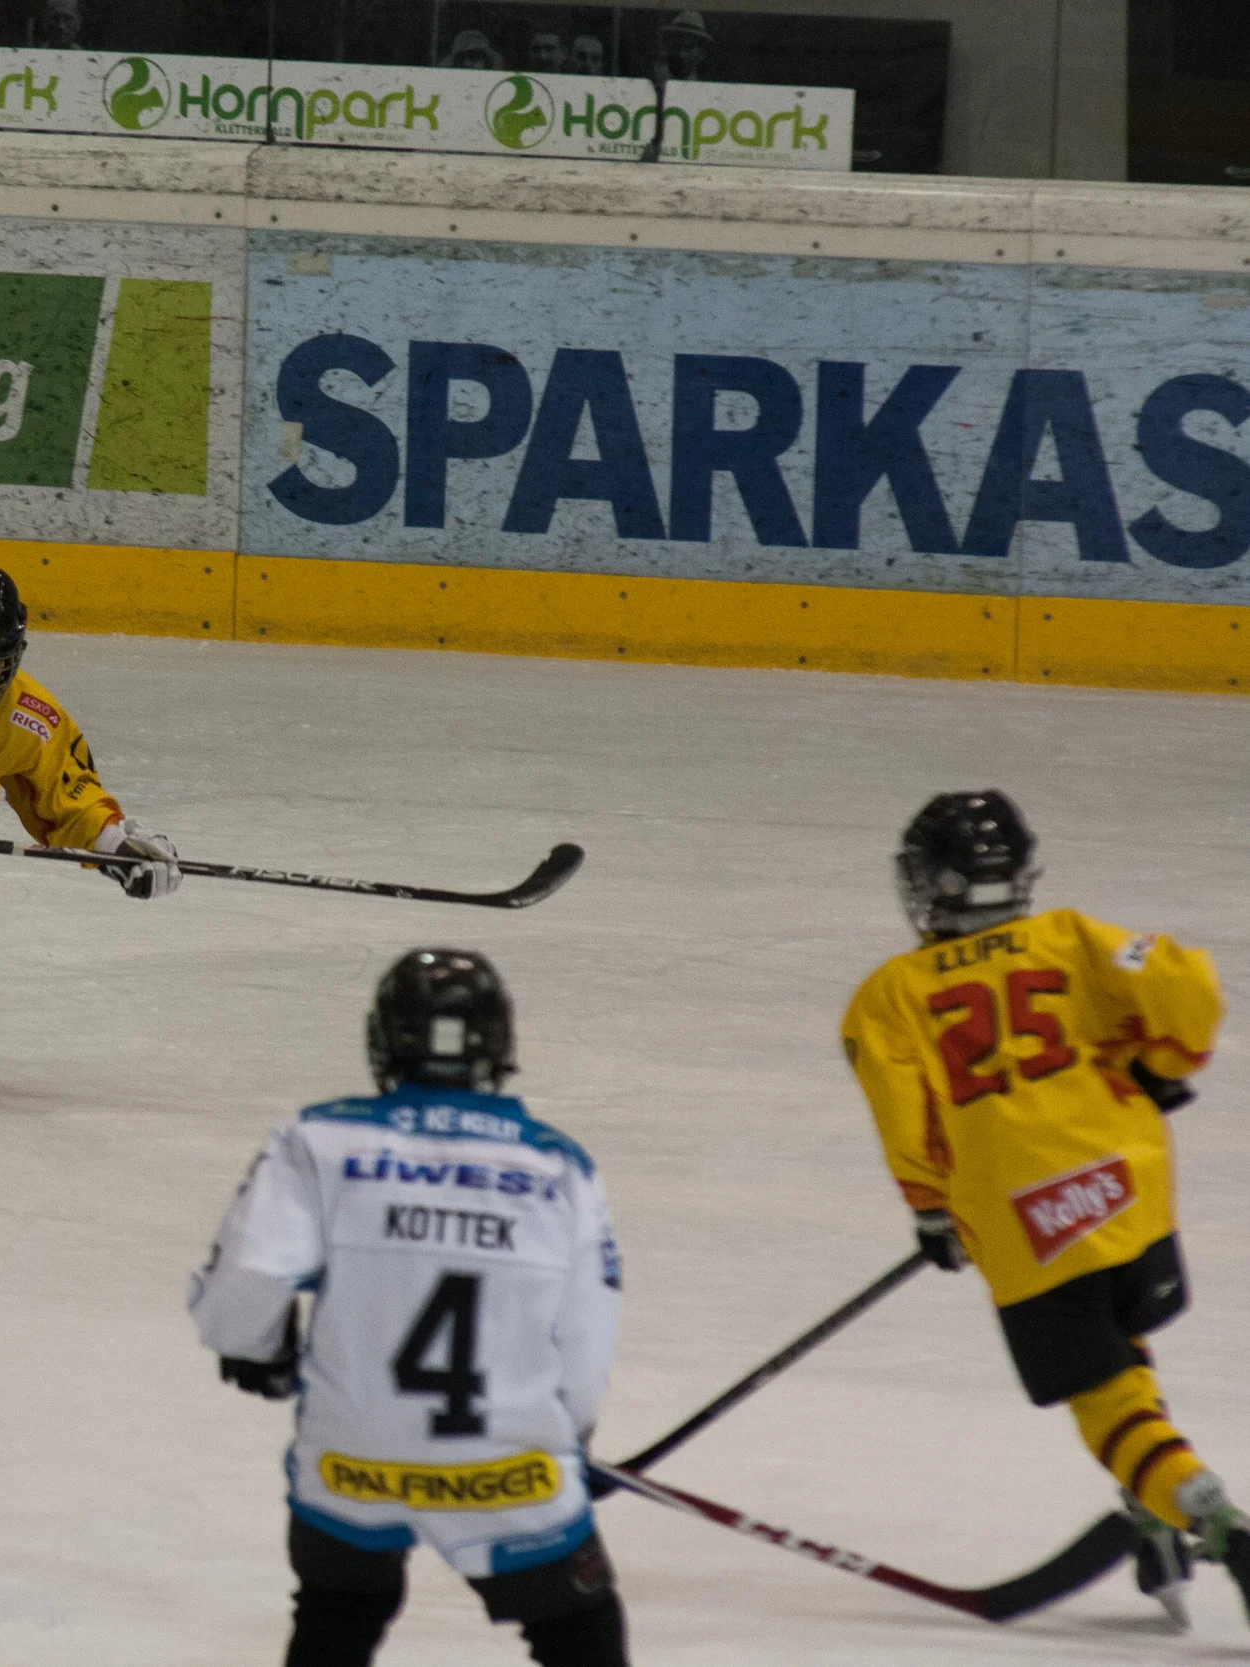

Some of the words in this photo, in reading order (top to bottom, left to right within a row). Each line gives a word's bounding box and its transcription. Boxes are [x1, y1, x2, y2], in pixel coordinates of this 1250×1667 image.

[178, 74, 441, 140] Hornpark
[266, 333, 1250, 568] SPARKAS
[927, 968, 1078, 1107] 25
[384, 1204, 518, 1252] KOTTEK
[390, 1267, 488, 1439] 4
[330, 1459, 555, 1502] PALFINGER
